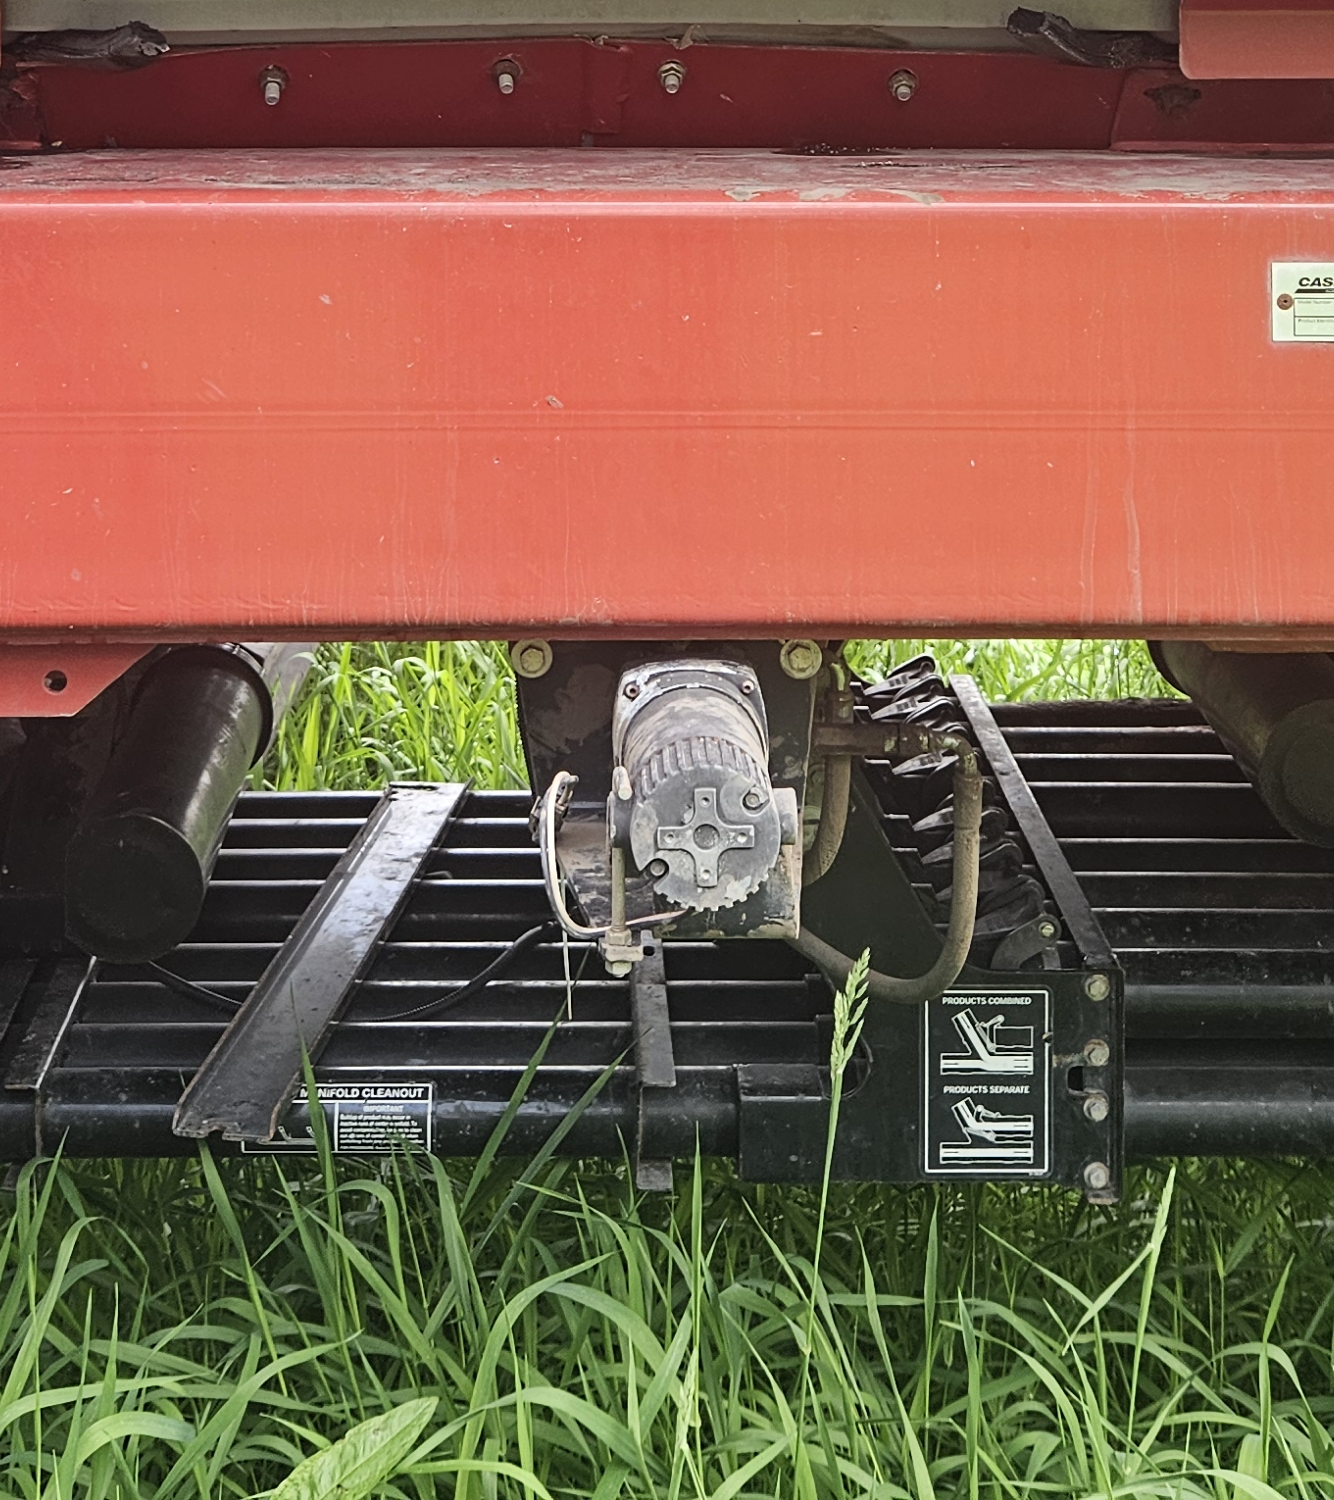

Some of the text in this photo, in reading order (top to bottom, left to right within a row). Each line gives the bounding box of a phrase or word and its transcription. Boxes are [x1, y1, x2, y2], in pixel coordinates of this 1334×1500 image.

[942, 996, 1032, 1005] PRODUCTS COMBINED
[300, 1087, 424, 1098] MNIFOLD CLEANOUT
[943, 1085, 1030, 1094] PRODUCTS SEPARATE
